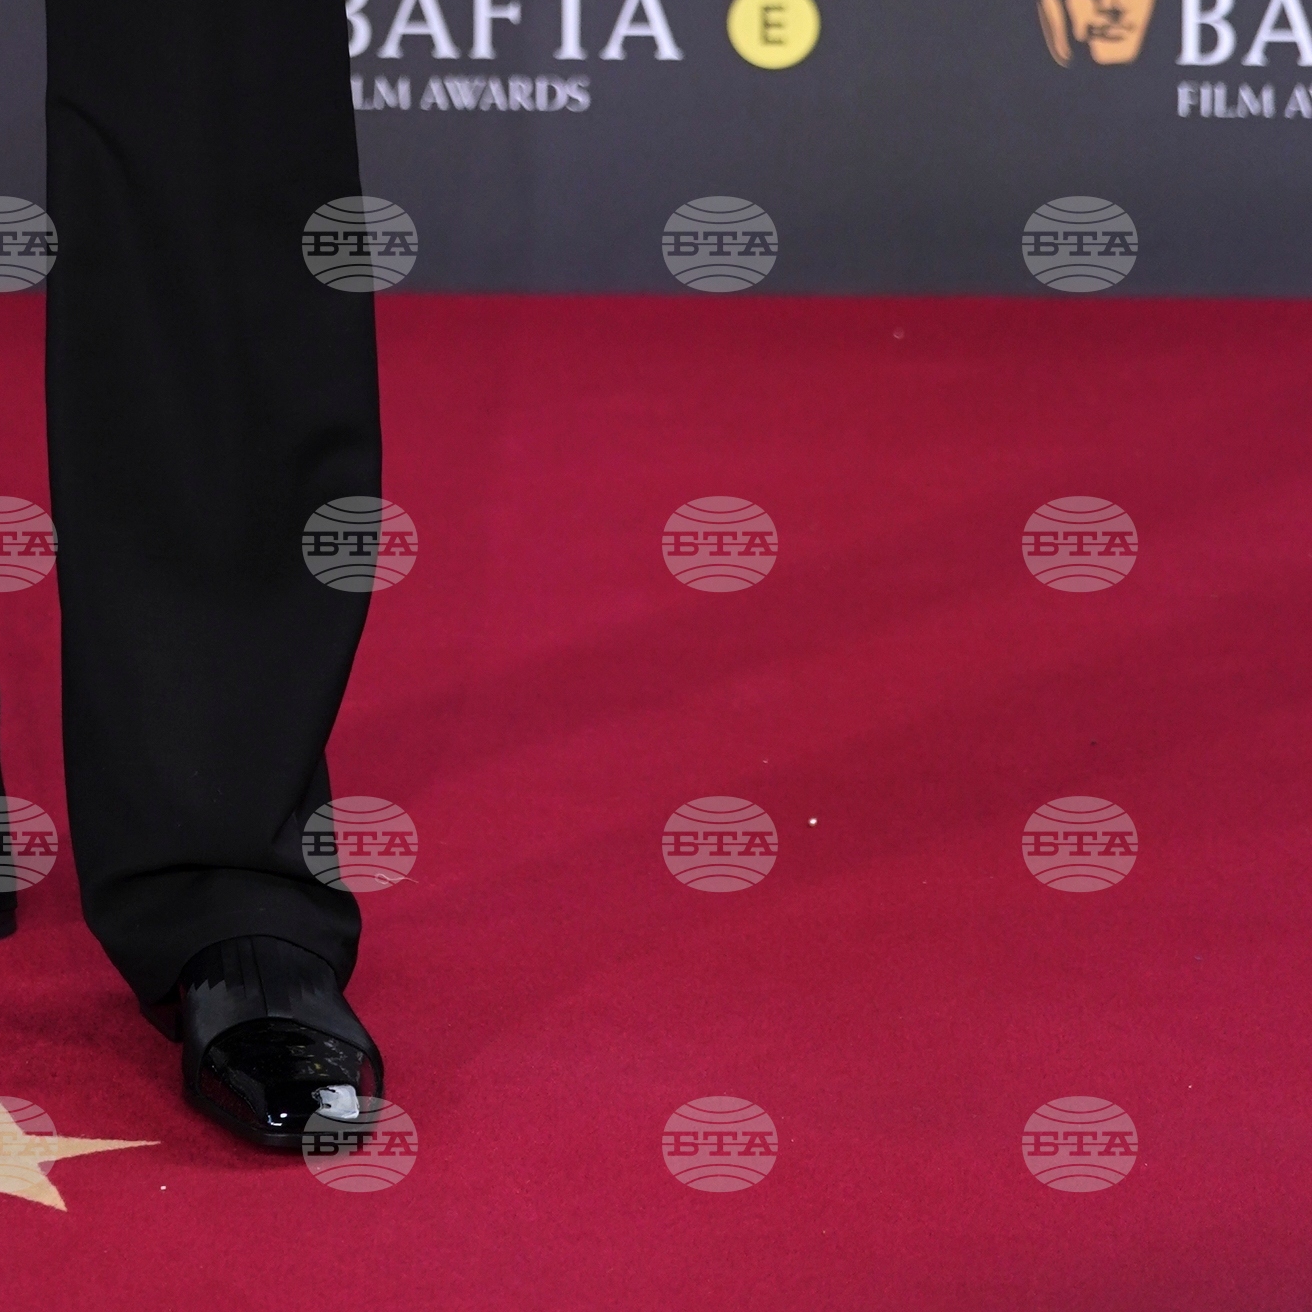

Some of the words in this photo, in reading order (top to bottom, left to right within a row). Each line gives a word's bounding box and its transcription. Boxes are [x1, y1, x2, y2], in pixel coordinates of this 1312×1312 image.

[350, 76, 412, 110] LM
[421, 76, 590, 111] AWARDS
[1177, 82, 1275, 118] FILM
